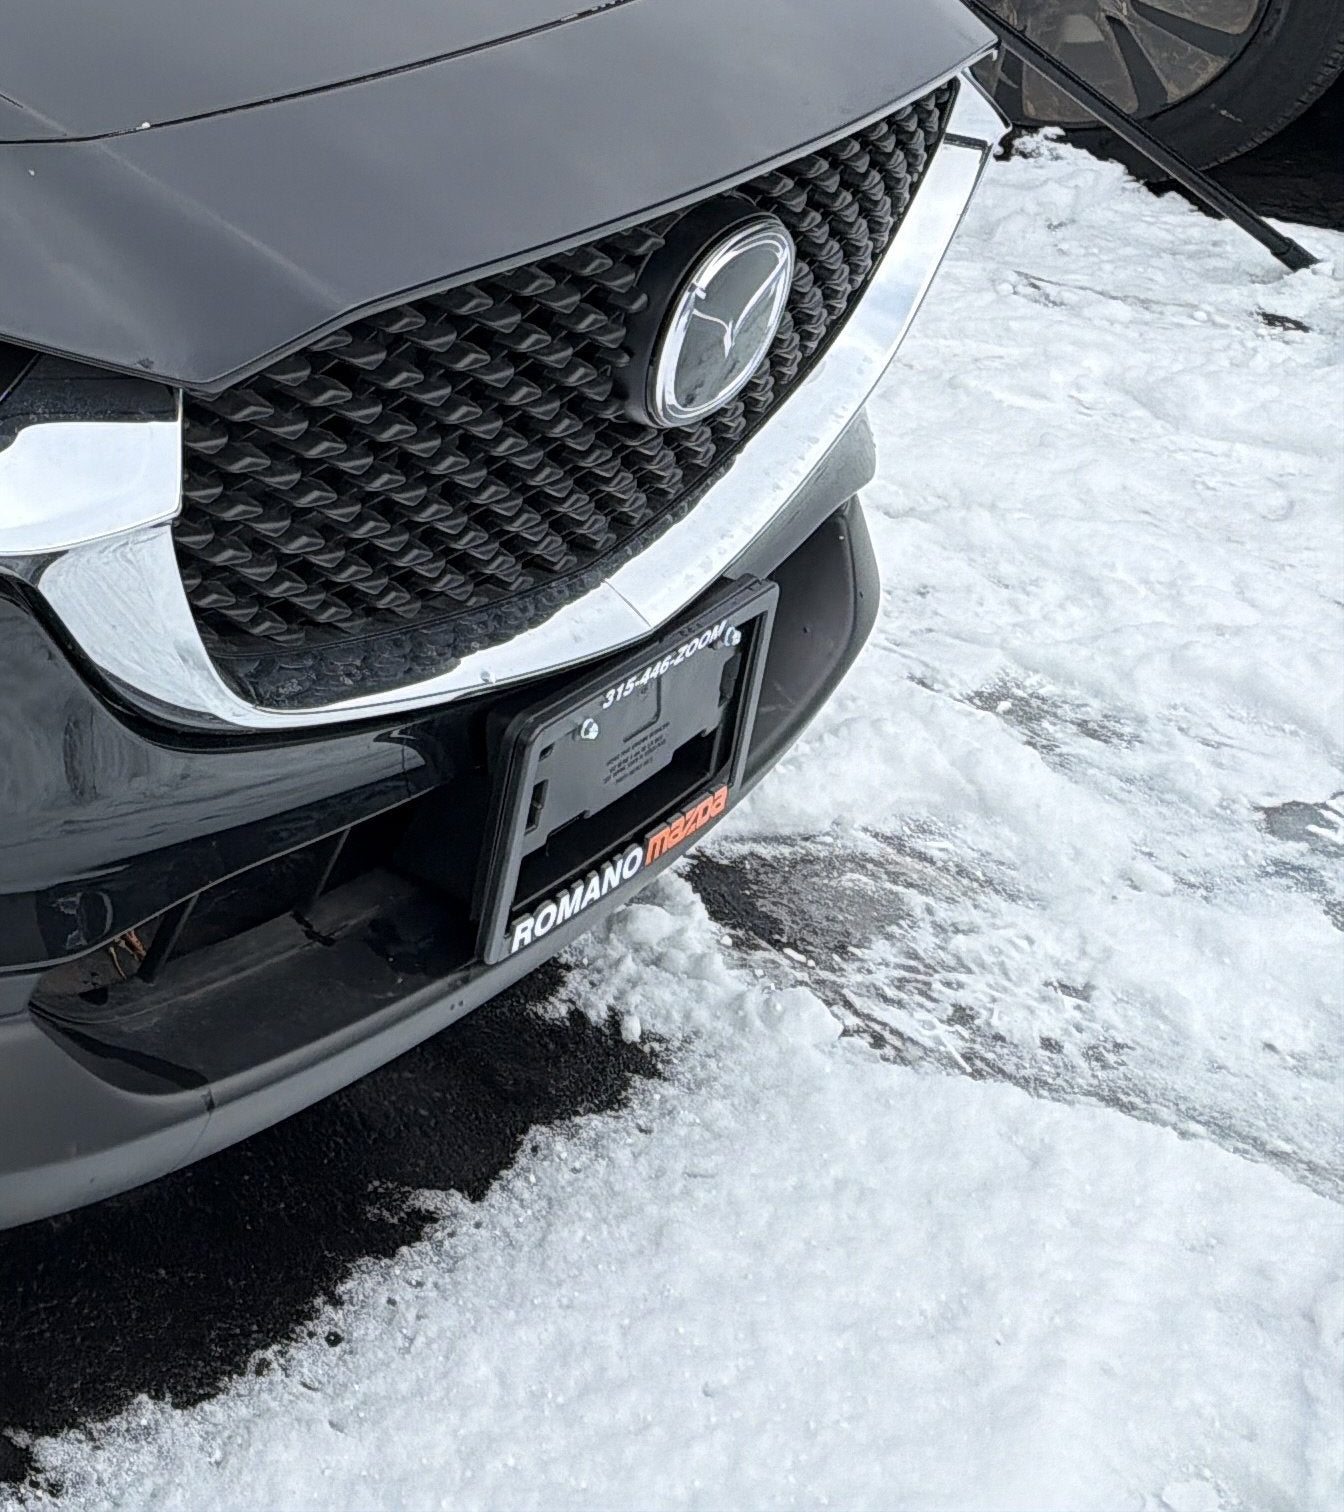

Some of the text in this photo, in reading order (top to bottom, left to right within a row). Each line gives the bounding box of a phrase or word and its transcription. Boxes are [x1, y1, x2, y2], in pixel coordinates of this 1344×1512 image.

[602, 619, 728, 709] 315-446-ZOOM
[511, 785, 728, 954] ROMANO mazda
